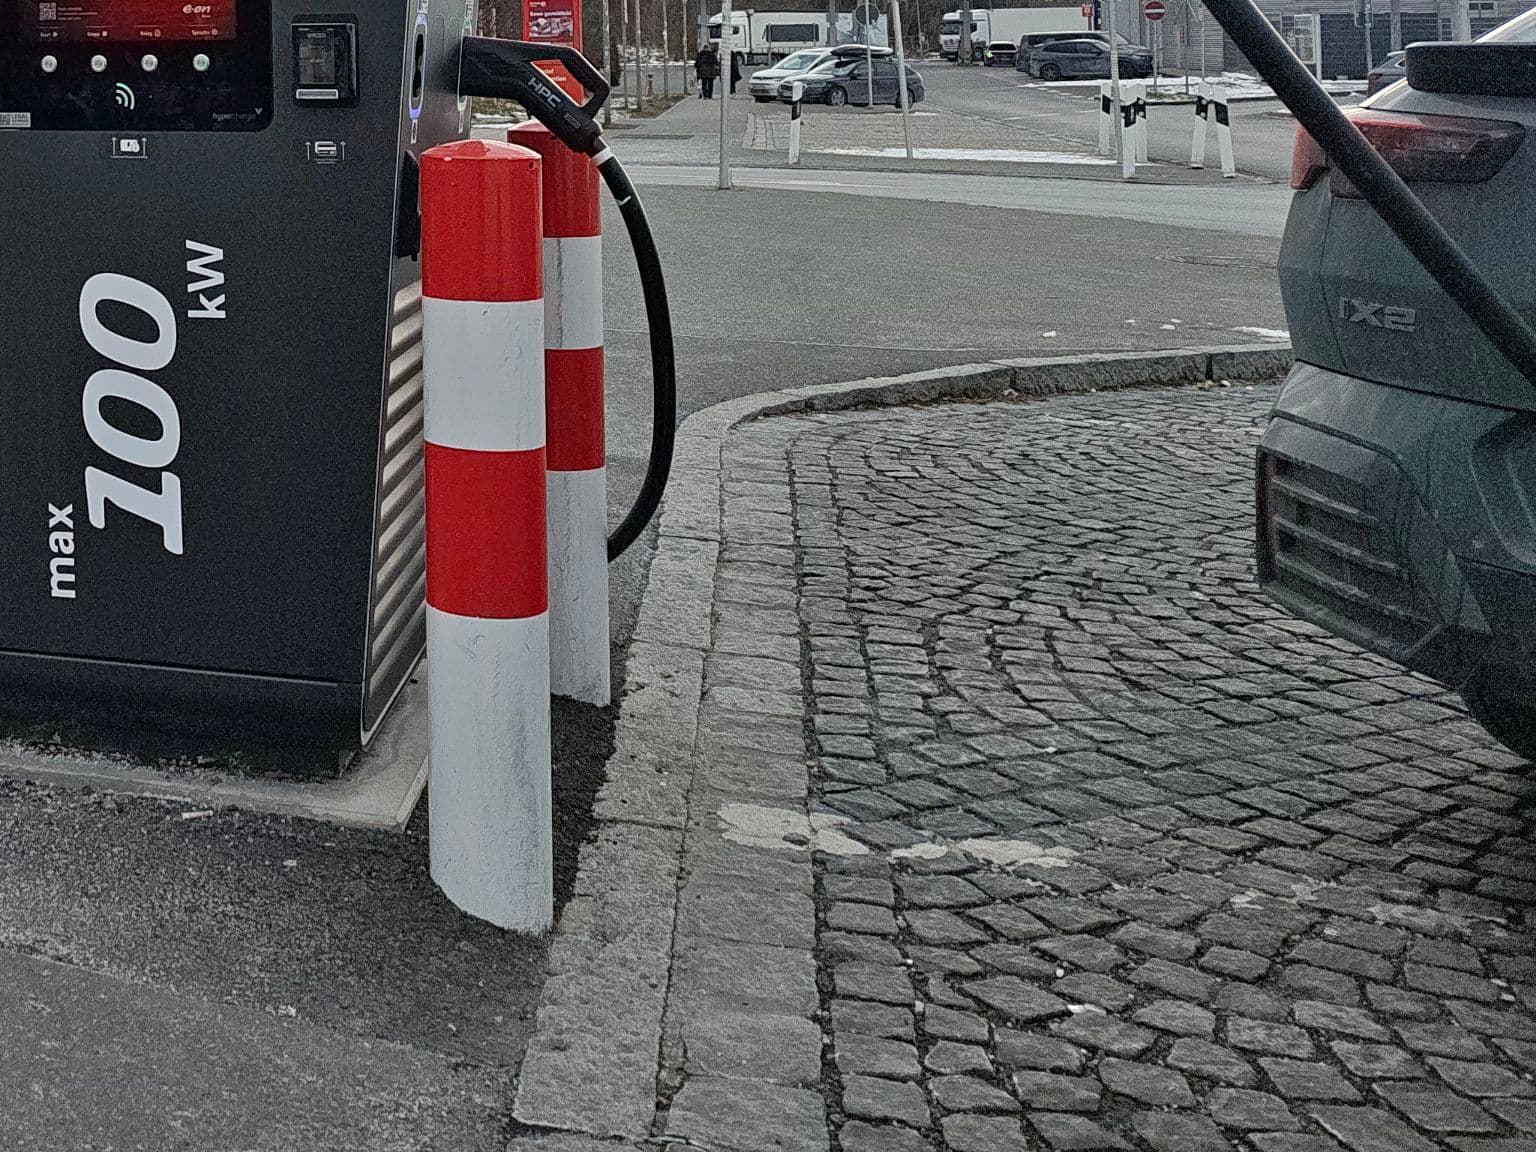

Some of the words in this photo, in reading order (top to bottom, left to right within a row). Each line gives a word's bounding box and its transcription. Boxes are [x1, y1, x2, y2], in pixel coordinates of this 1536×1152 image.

[527, 77, 562, 108] HPC
[185, 239, 226, 318] kW
[79, 272, 184, 555] 100
[48, 502, 76, 599] max
